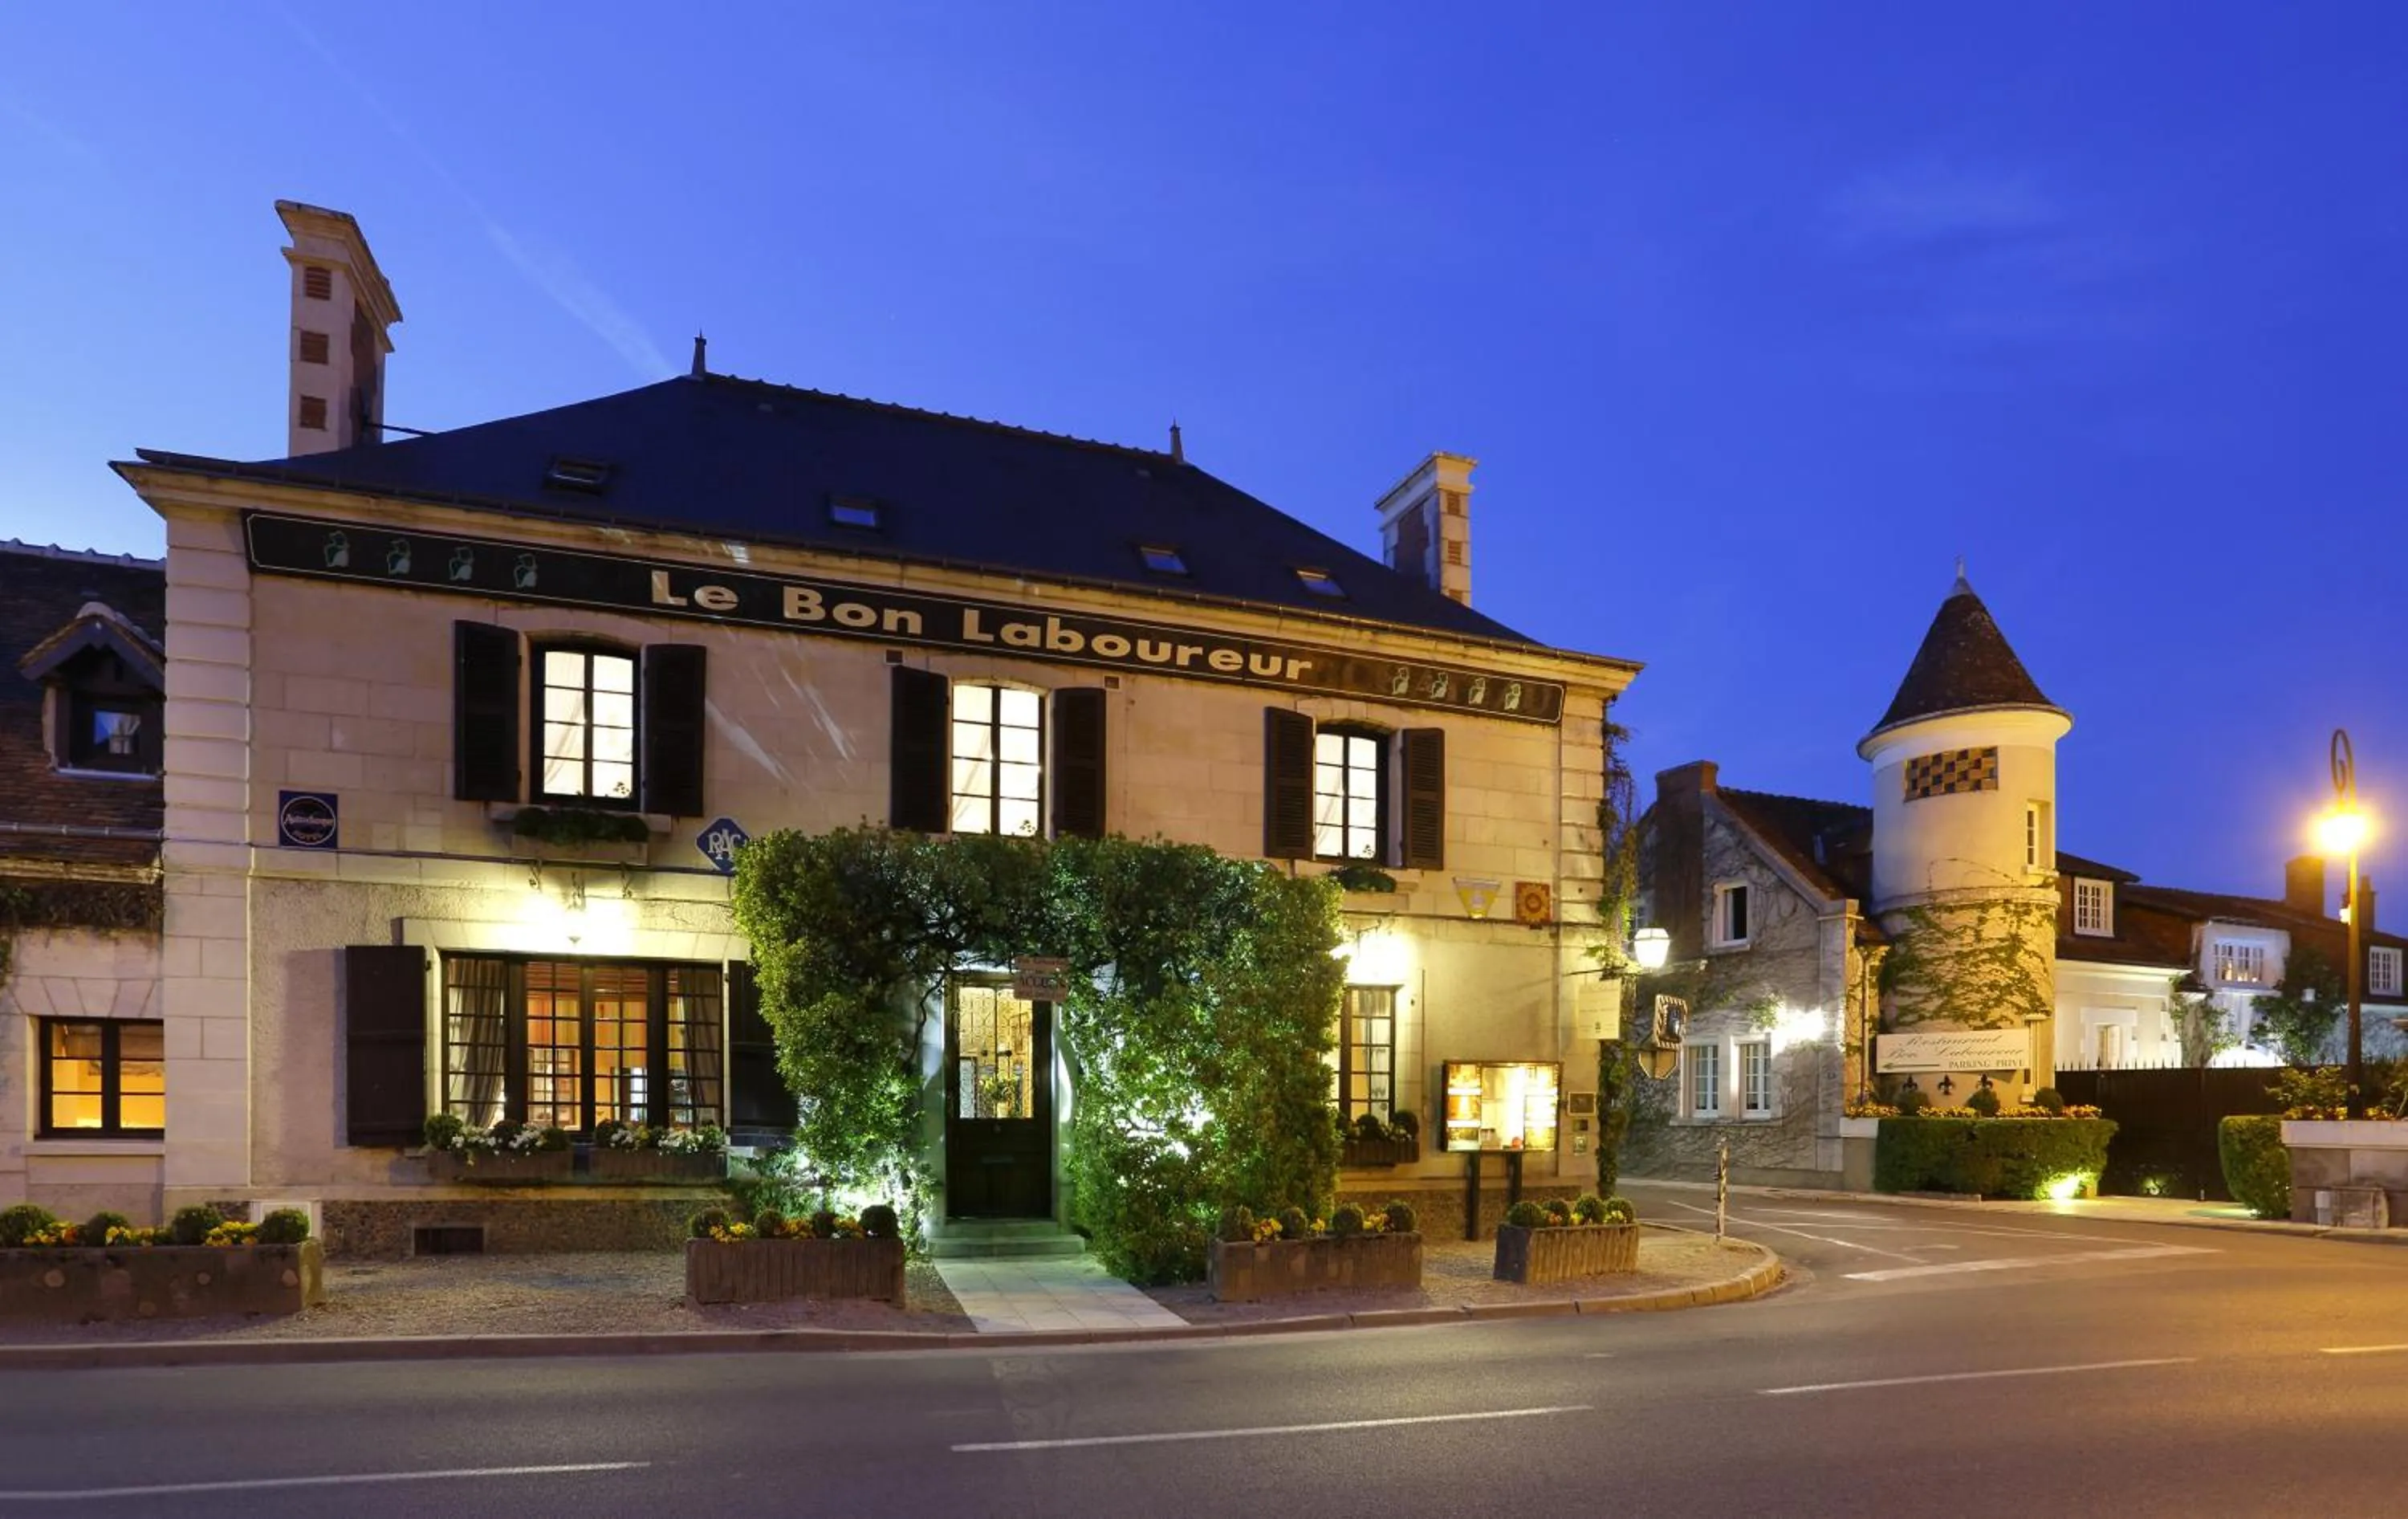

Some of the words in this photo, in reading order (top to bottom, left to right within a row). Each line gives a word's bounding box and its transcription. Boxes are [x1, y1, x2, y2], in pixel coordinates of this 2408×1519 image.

[651, 570, 738, 611] Le
[783, 586, 922, 635] Bon
[963, 609, 1312, 680] Laboureur
[1949, 1060, 1990, 1069] PARKING
